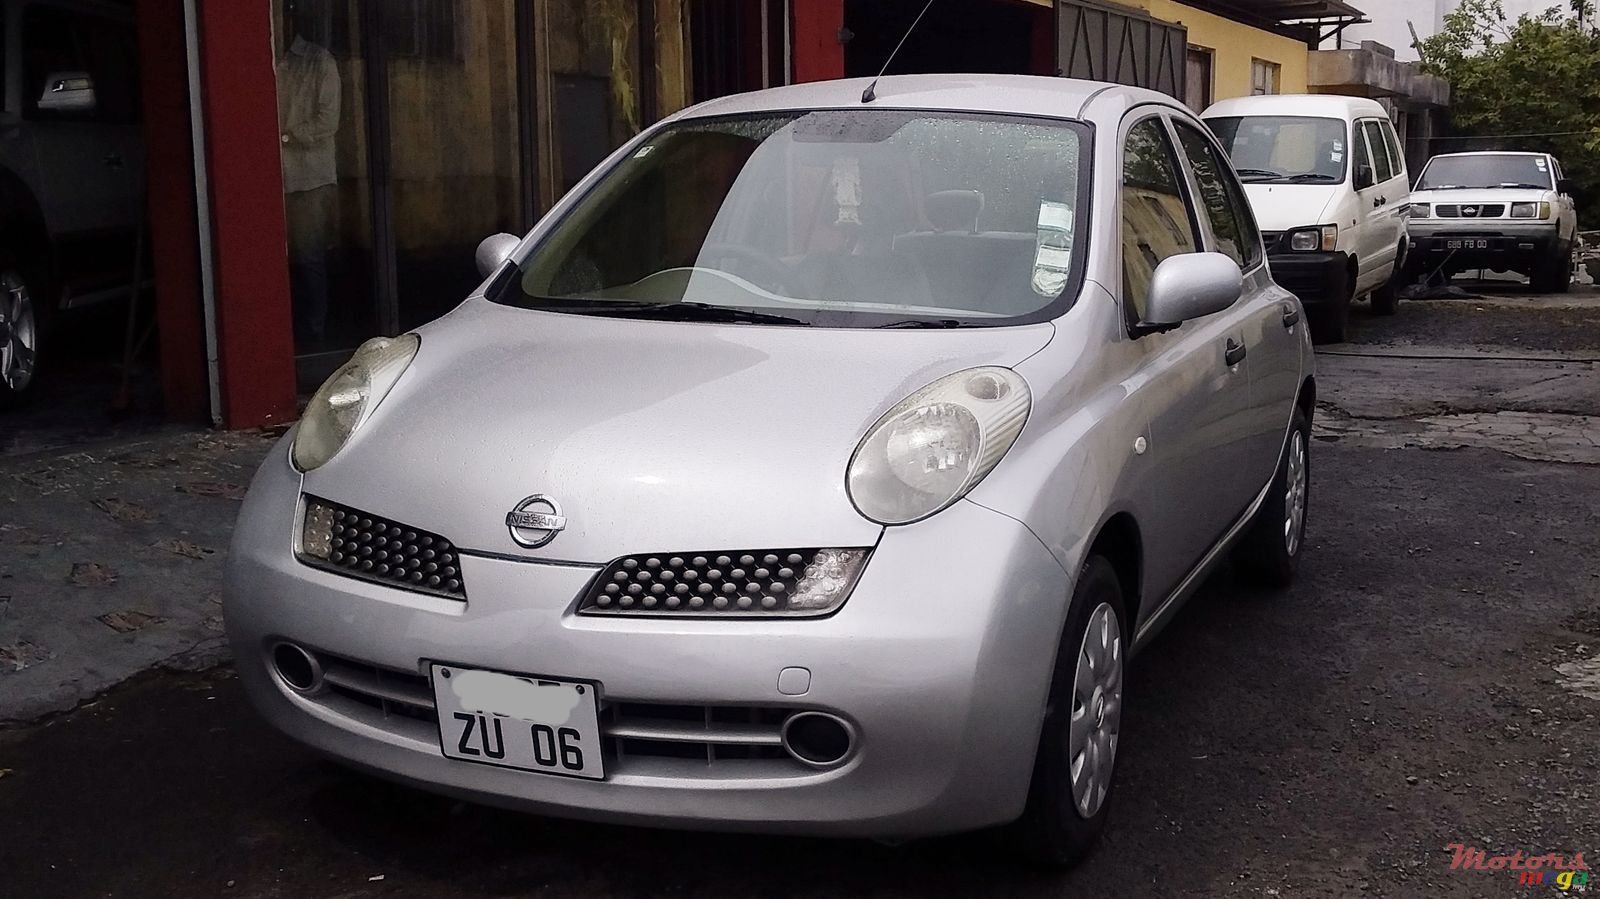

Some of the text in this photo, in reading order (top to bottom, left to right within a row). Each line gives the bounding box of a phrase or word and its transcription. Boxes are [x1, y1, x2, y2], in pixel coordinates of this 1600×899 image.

[510, 513, 558, 527] NISSAN
[453, 711, 584, 771] ZU 06
